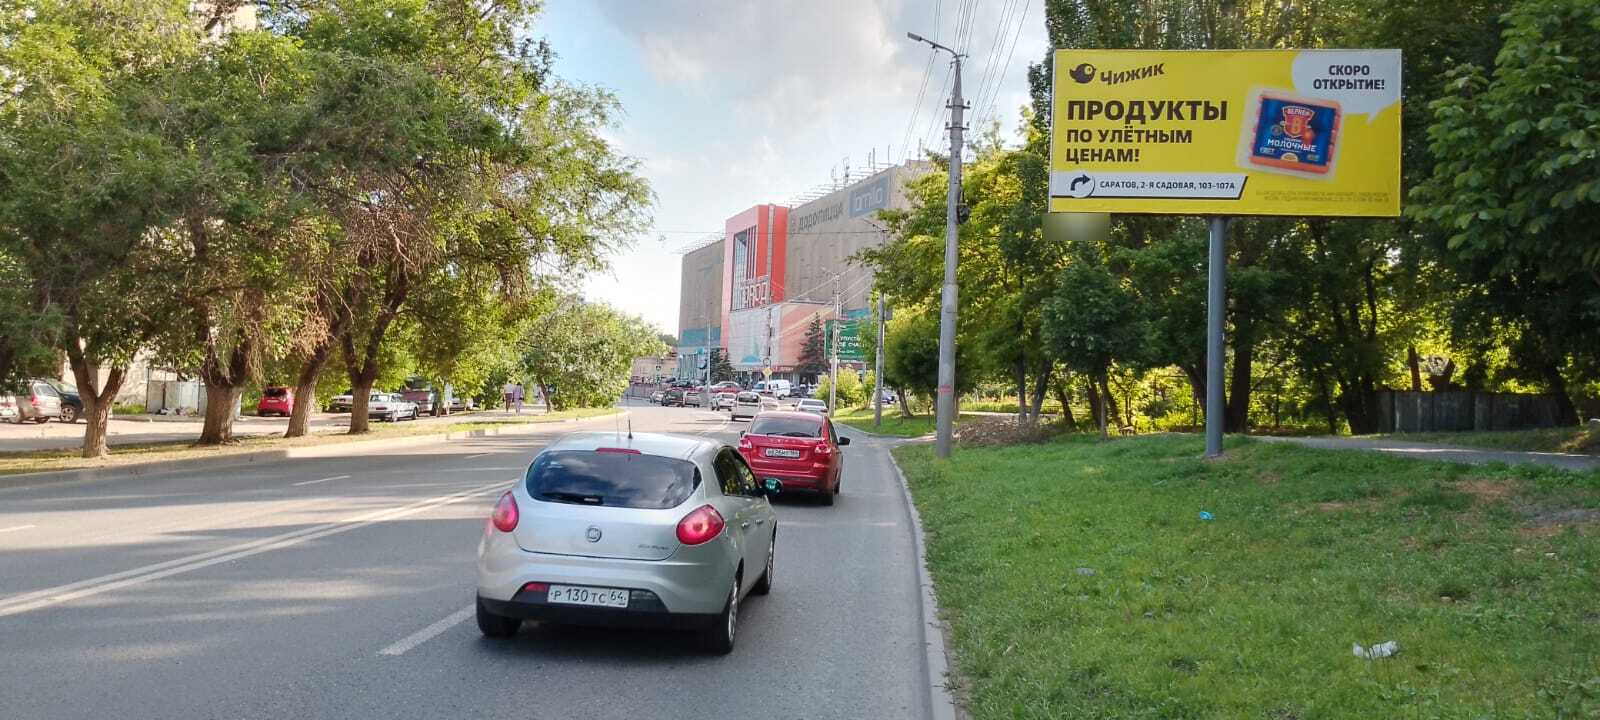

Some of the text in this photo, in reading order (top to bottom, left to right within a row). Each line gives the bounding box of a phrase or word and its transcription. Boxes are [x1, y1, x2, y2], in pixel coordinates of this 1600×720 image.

[1329, 65, 1369, 75] СКОРО
[1313, 79, 1385, 90] ОТКРЫТИЕ!
[1067, 100, 1228, 124] ПРОДУКТЫ
[1067, 125, 1192, 143] ПО УЛЁТНЫМ
[1267, 139, 1317, 153] МОЛОЧНЫЕ
[1066, 148, 1140, 164] ЦЕНАМ!
[1100, 180, 1139, 190] САРАТОВ,
[1140, 180, 1154, 189] 2-Я
[1156, 181, 1197, 191] САДОВАЯ,
[567, 588, 588, 602] 130
[611, 591, 624, 601] 64
